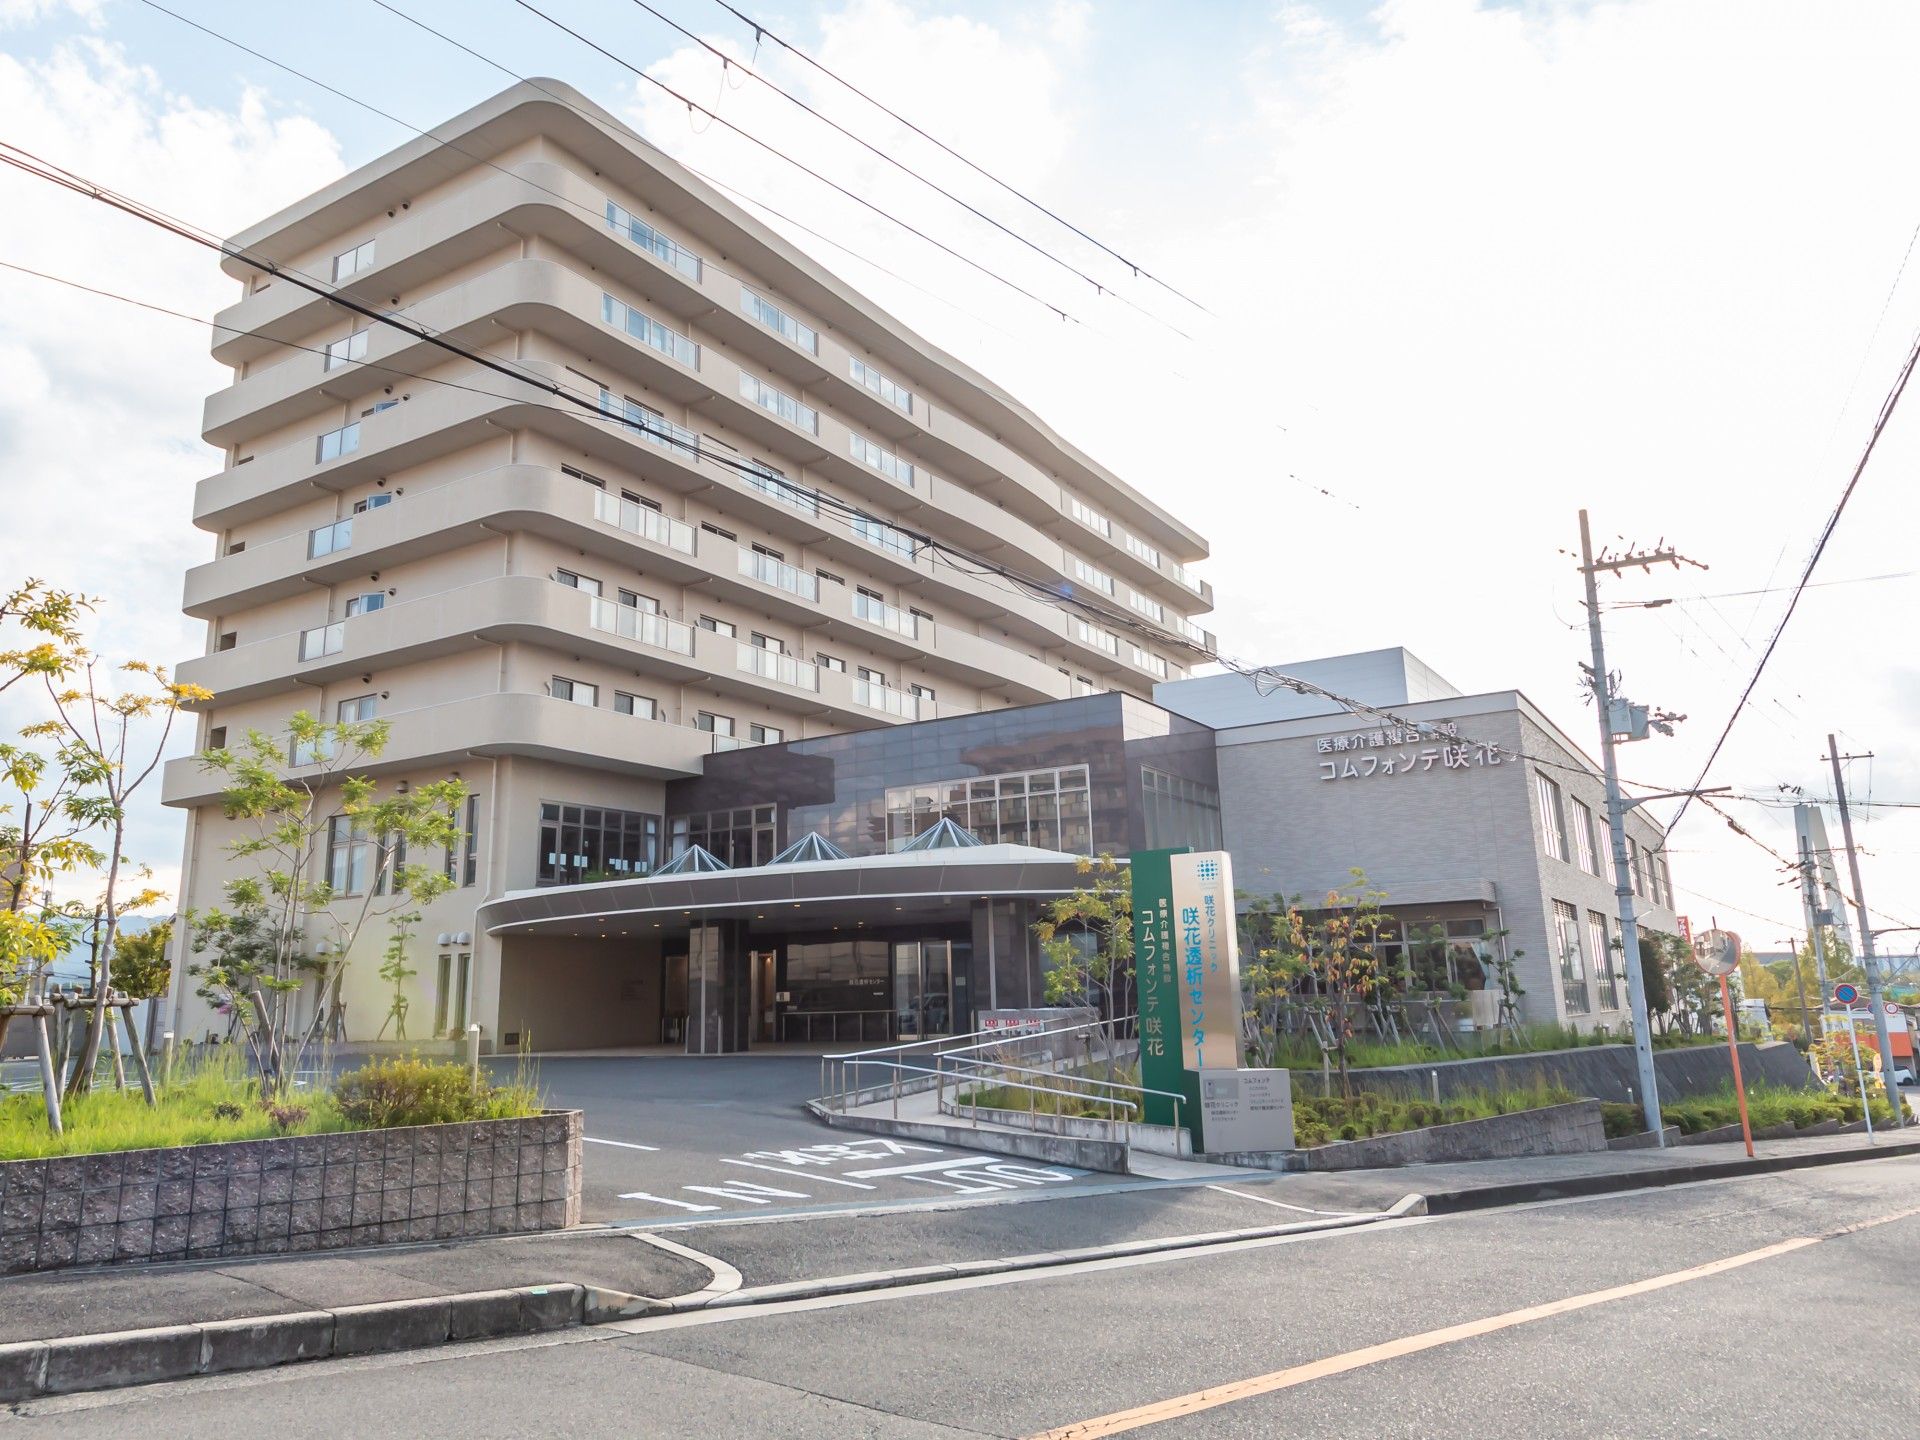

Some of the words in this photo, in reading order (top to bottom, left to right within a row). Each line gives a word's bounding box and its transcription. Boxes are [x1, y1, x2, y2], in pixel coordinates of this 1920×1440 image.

[1317, 722, 1457, 753] 医療介護複合設
[1319, 741, 1501, 780] コムフォンテ咲花
[1204, 894, 1218, 972] 咲花クリニック
[1142, 910, 1164, 1056] コムフォンテ咲花
[1182, 906, 1204, 1067] 咲花透析センター
[617, 1180, 811, 1211] IN
